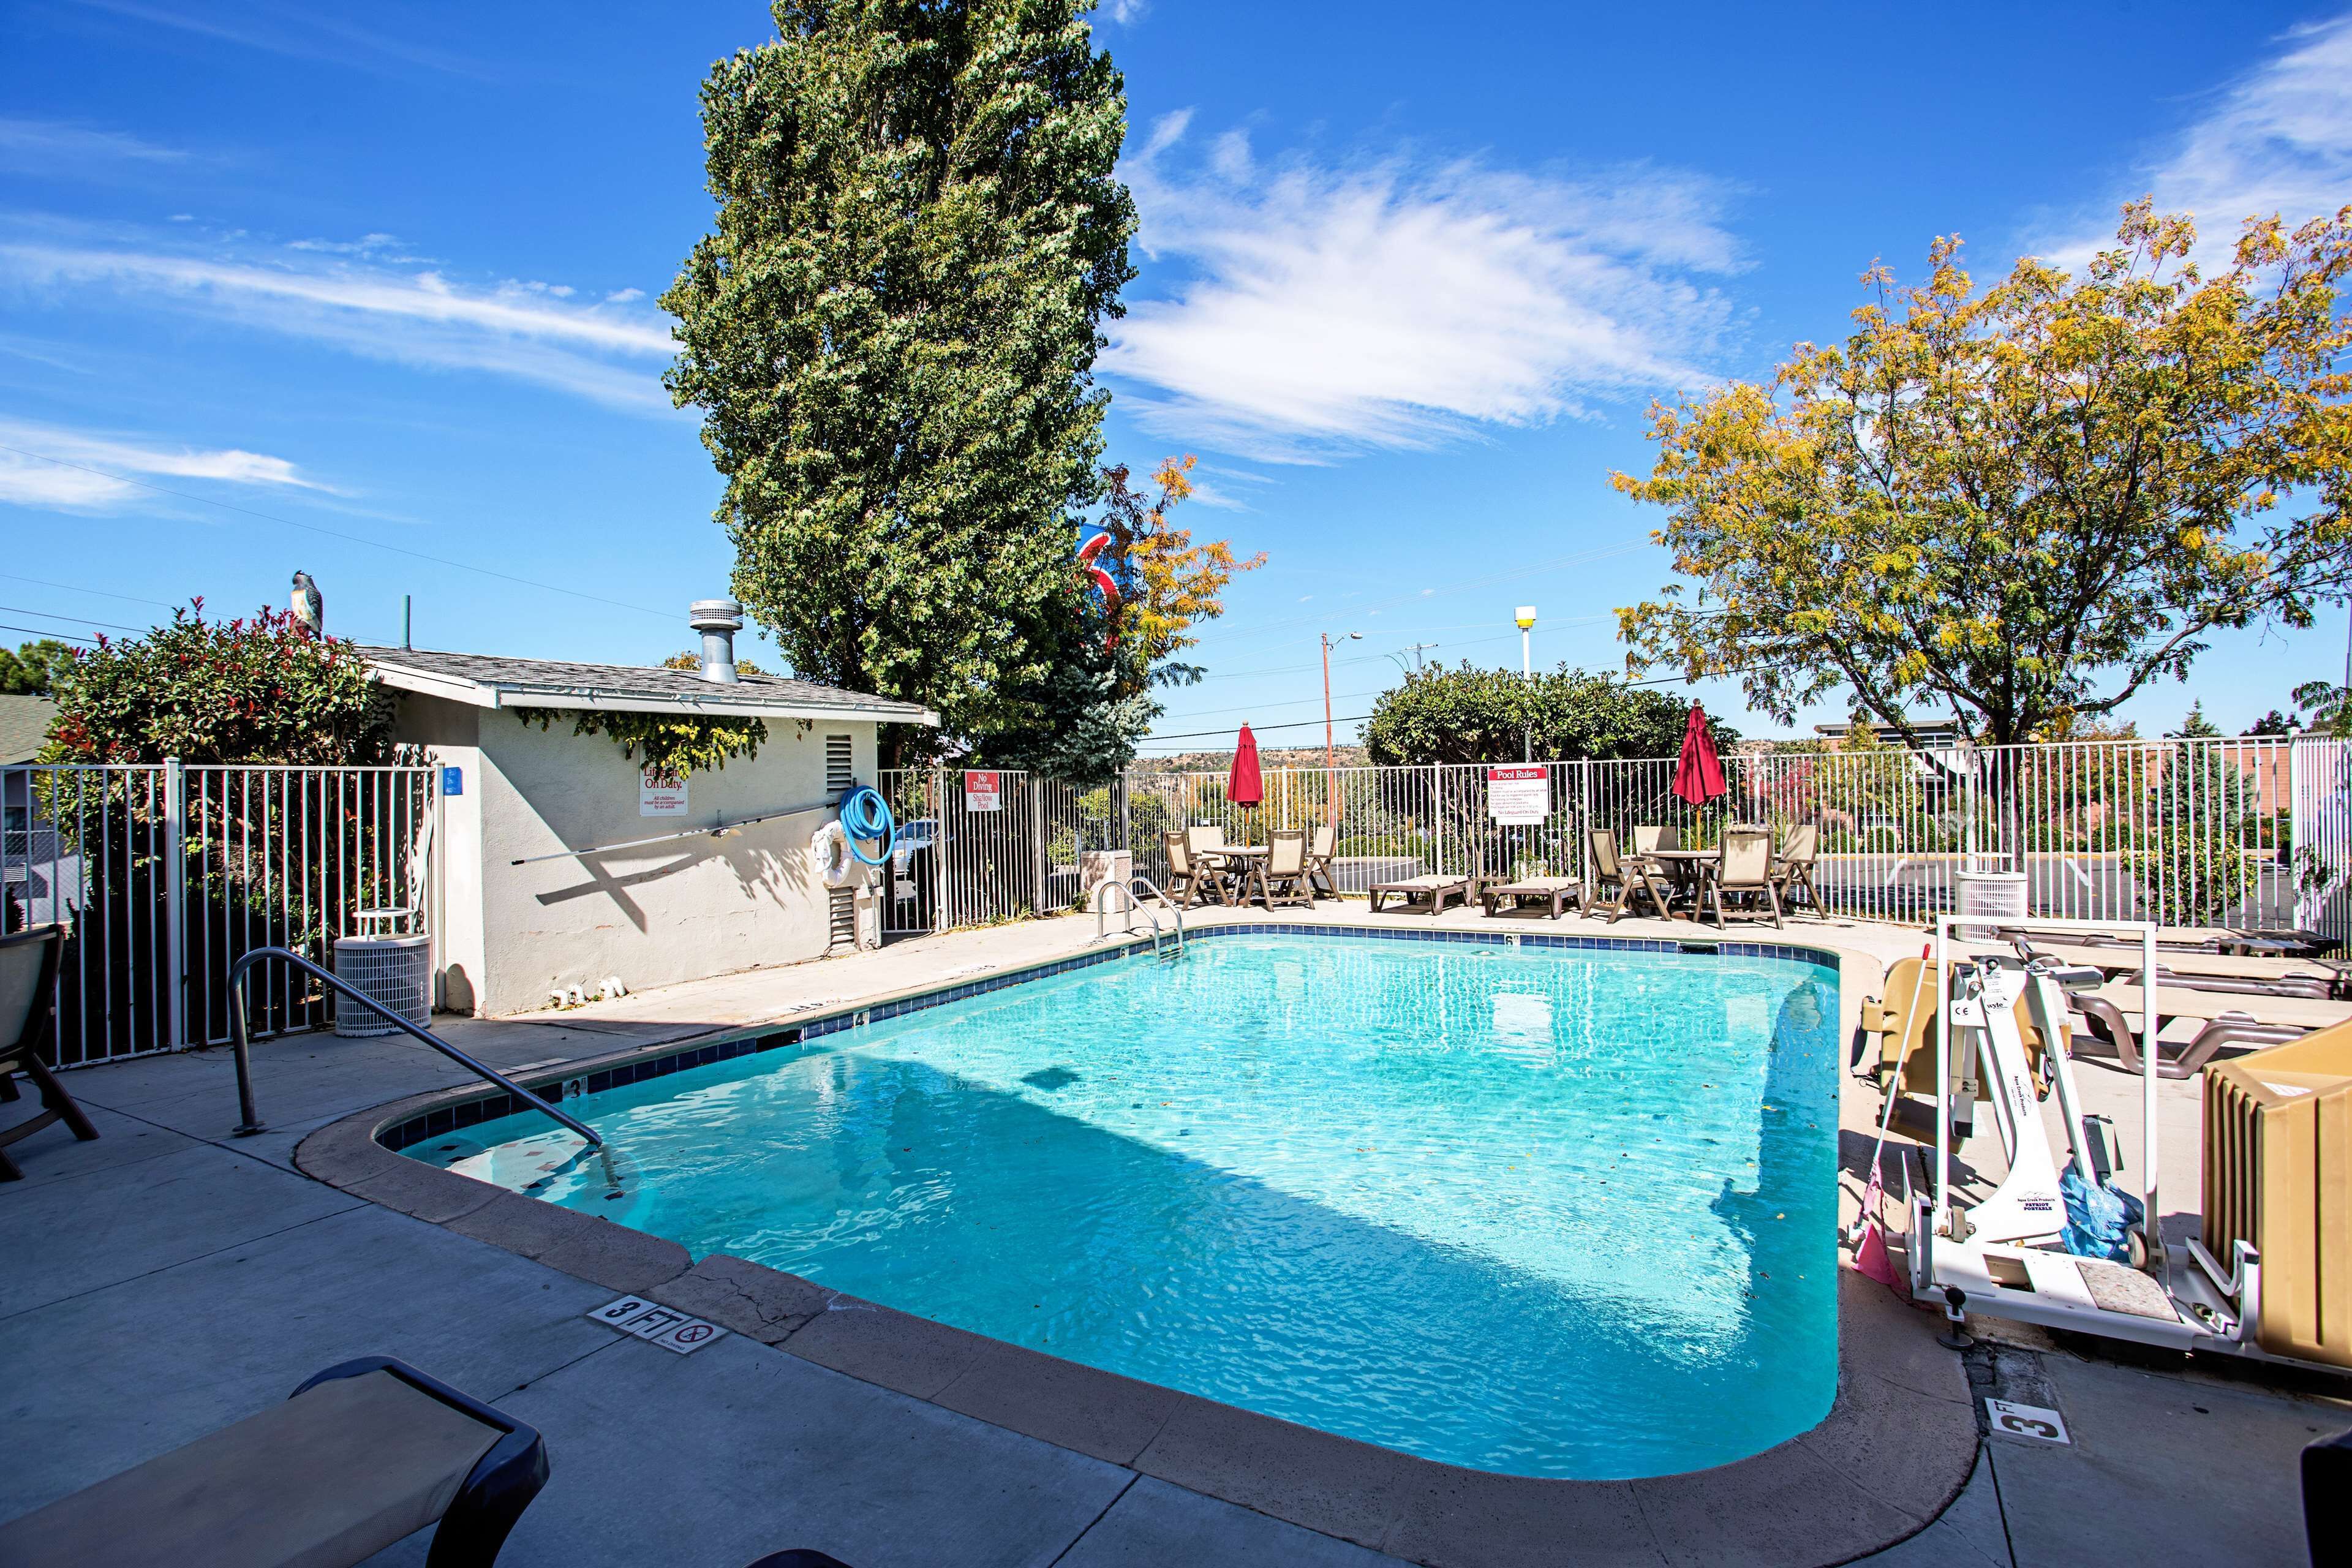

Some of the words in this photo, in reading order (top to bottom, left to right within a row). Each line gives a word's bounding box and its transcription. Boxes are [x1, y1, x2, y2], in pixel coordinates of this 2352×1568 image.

[978, 773, 987, 783] No
[1497, 771, 1515, 779] Pool
[1516, 769, 1538, 778] Rules
[645, 778, 658, 789] On
[973, 782, 992, 793] Diving
[1955, 1007, 1969, 1016] CE
[570, 1079, 581, 1099] 3
[605, 1302, 641, 1317] 3
[627, 1310, 684, 1334] FT
[668, 1341, 686, 1351] DIVING
[1994, 1400, 2015, 1414] FT
[2000, 1415, 2059, 1438] 3
